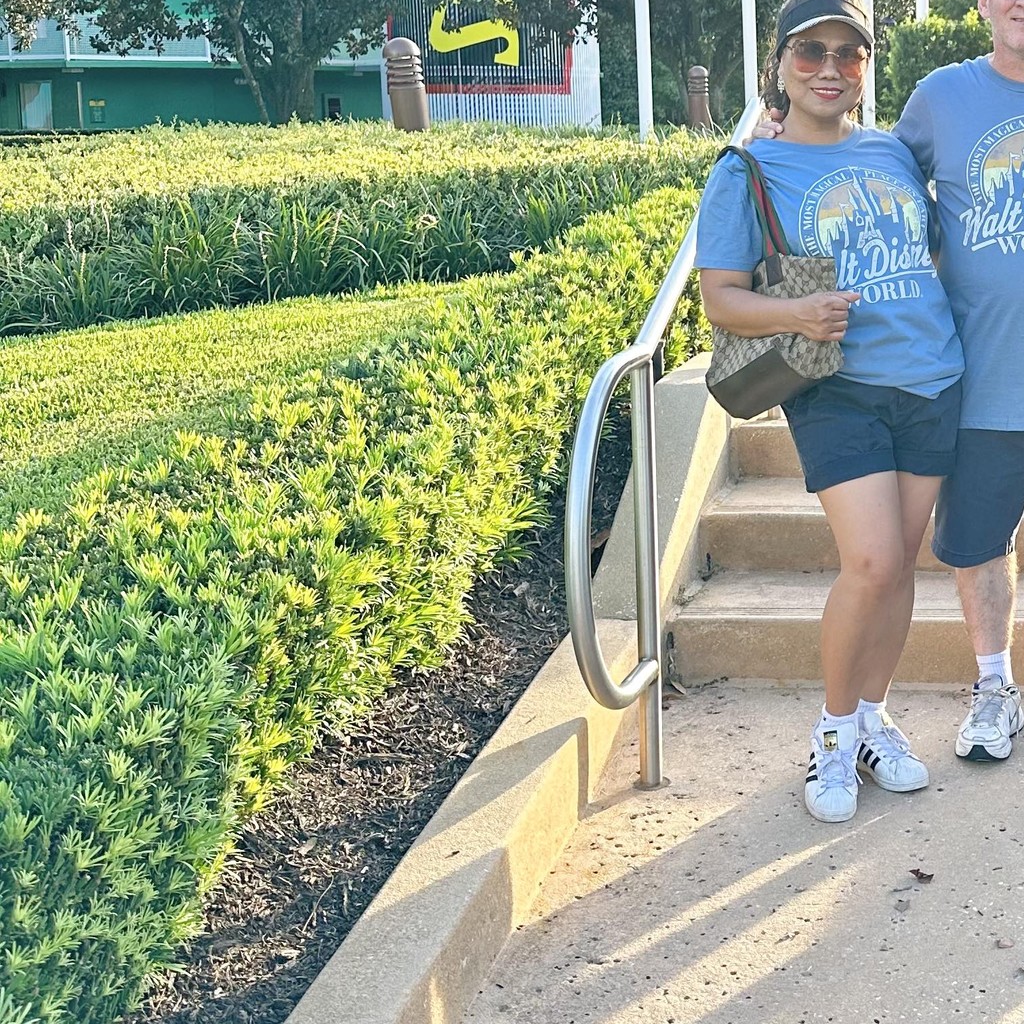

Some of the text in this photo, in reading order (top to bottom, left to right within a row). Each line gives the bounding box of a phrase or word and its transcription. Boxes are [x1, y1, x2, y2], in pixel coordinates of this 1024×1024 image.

[970, 146, 986, 176] MOST
[803, 199, 817, 231] MOST
[959, 197, 1023, 246] Walt
[836, 237, 937, 289] lt Disne
